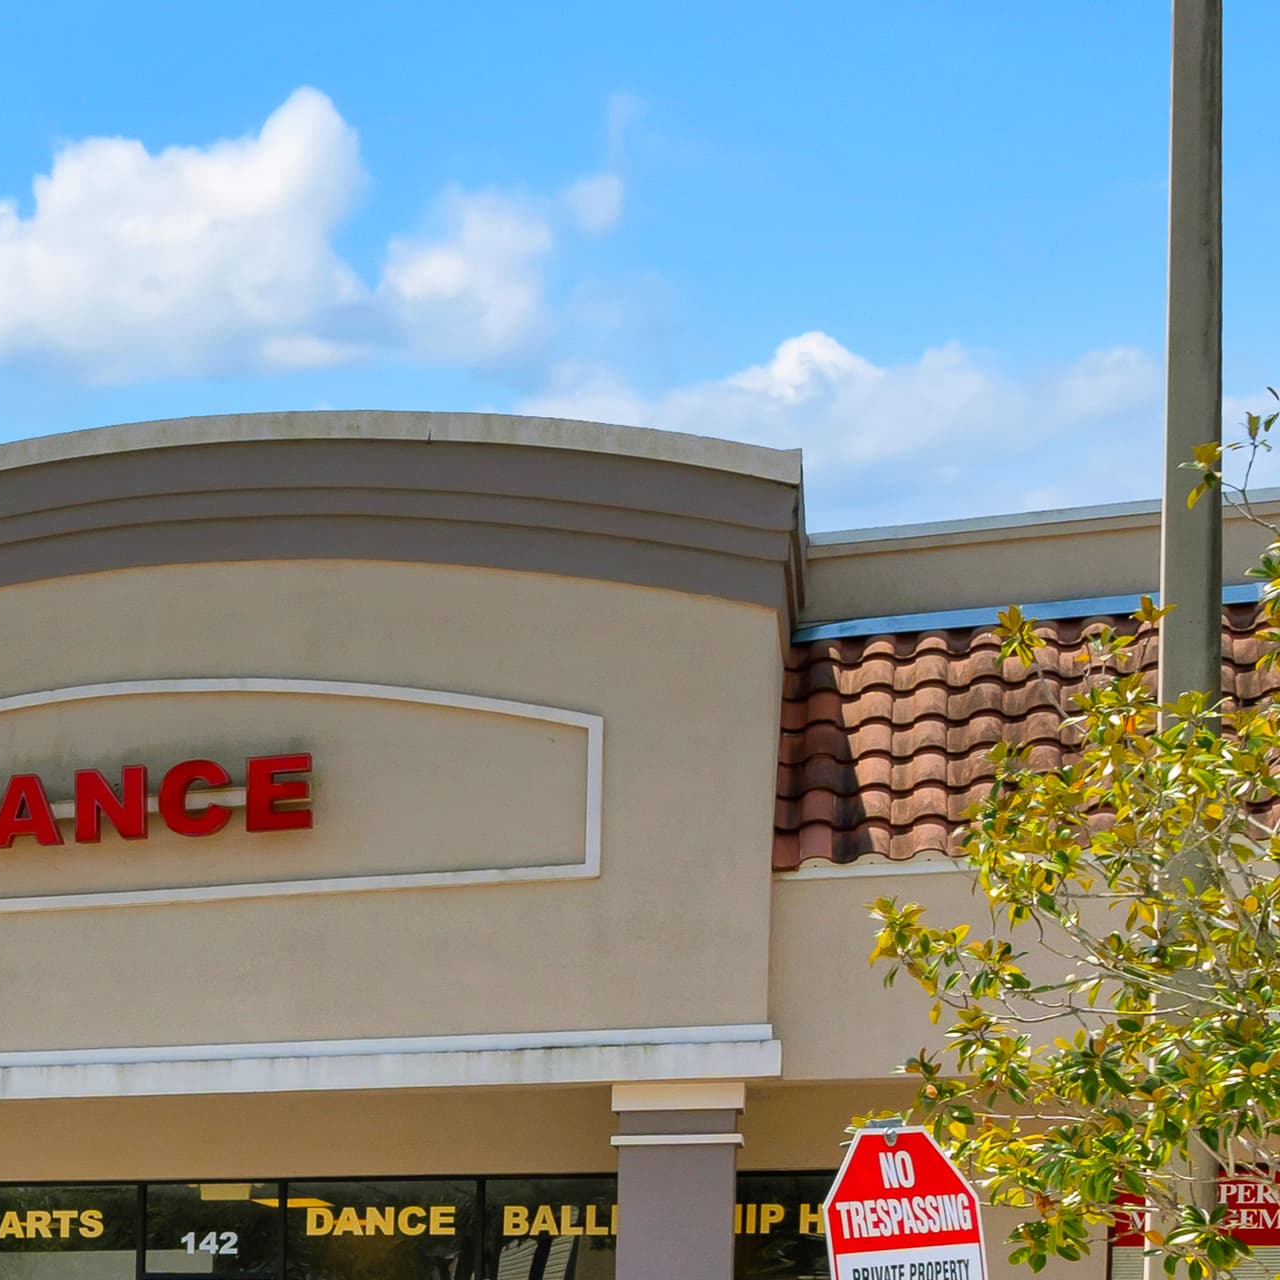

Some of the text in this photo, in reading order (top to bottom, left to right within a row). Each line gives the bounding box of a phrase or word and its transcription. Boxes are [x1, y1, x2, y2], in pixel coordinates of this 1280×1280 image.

[878, 1150, 915, 1189] NO
[306, 1205, 618, 1236] DANCE BALL
[735, 1204, 784, 1234] IP
[835, 1193, 973, 1240] TRESPASSING
[180, 1231, 238, 1255] 142
